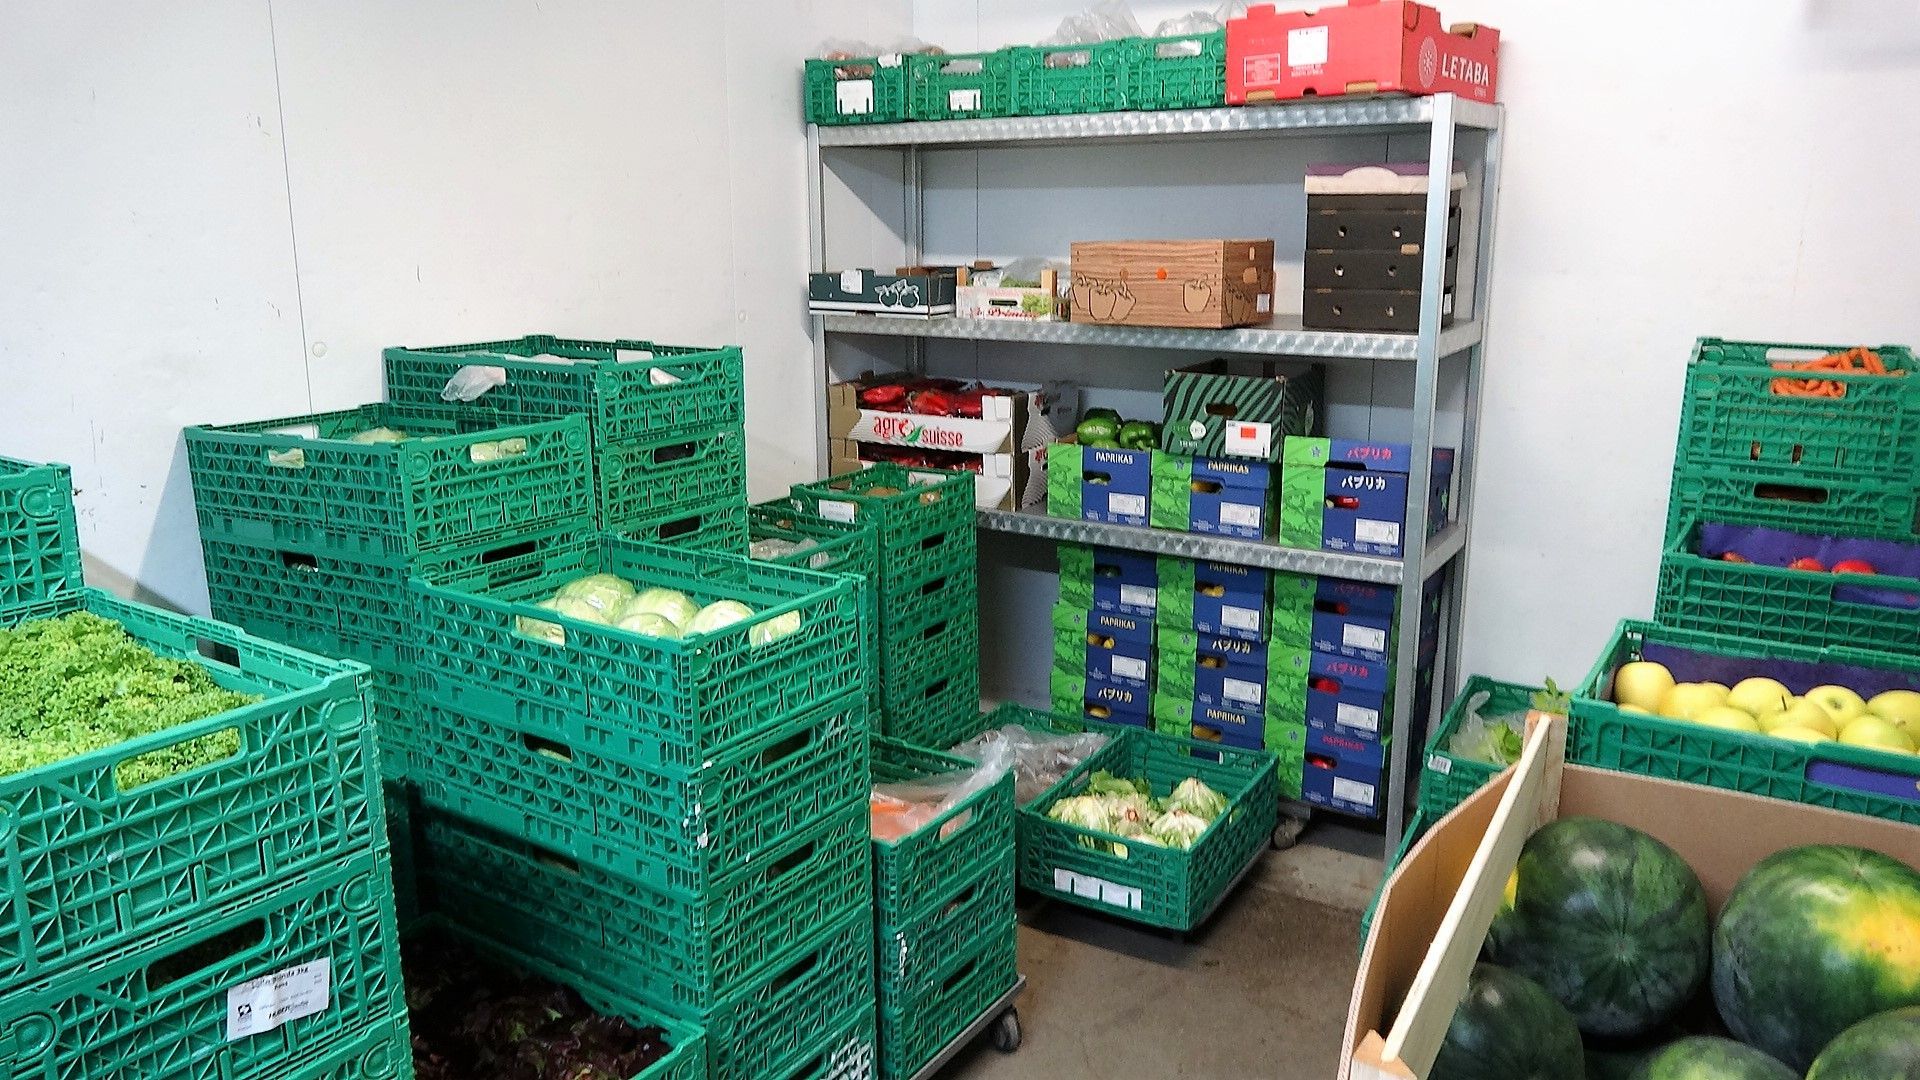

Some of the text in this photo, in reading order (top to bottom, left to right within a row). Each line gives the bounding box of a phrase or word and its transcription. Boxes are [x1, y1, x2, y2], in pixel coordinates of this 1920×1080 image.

[1441, 53, 1490, 87] LETABA
[922, 427, 964, 447] suisse
[1095, 451, 1134, 465] PAPRIKAS
[1346, 446, 1393, 461] パプリカ
[1207, 461, 1250, 475] PAPRIKAS
[1341, 474, 1387, 491] パプリカ
[1209, 563, 1249, 577] PAPRIKAS
[1100, 615, 1137, 631] PAPRIKAS
[1097, 687, 1133, 704] パプリカ
[1206, 708, 1247, 725] PAPRIKAS
[1321, 733, 1366, 752] PAPRIKAS
